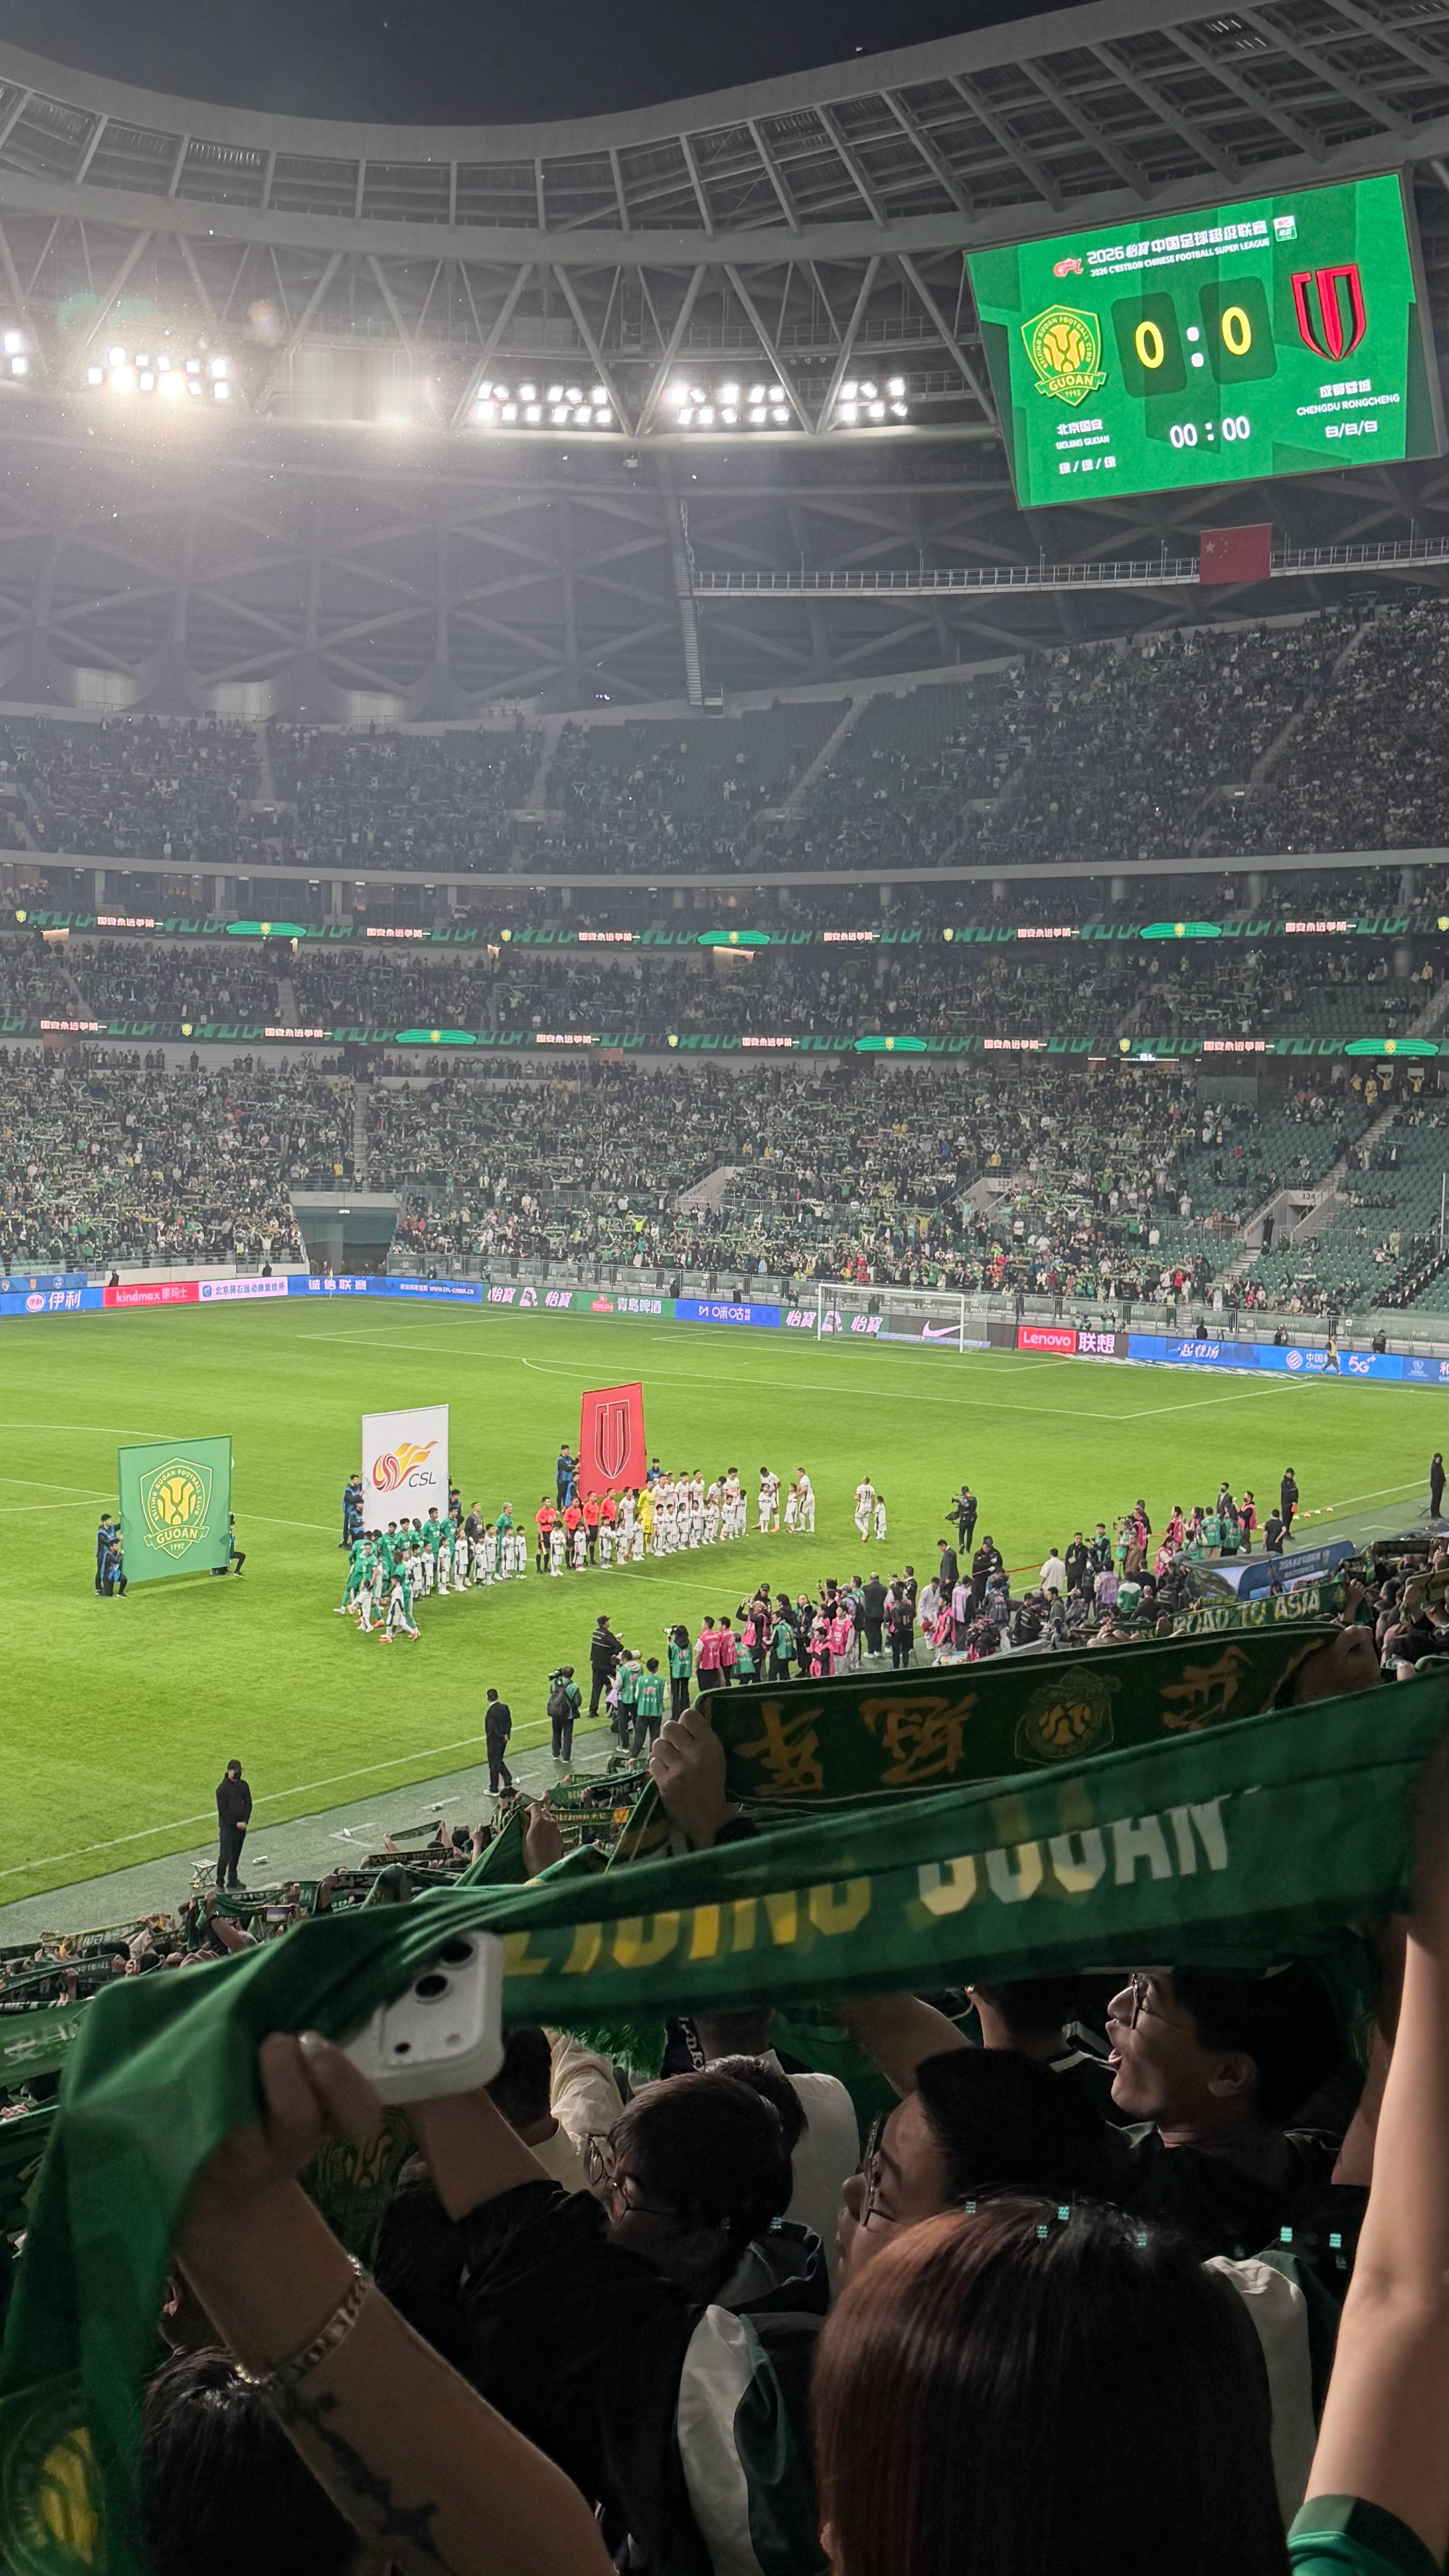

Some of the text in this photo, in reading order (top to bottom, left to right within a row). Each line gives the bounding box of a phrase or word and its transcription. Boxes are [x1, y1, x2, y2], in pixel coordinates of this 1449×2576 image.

[1144, 255, 1174, 267] CHINESE
[1175, 248, 1214, 262] FOOTBALL
[1214, 244, 1239, 255] SUPER
[1240, 238, 1270, 251] LEAGUE
[1049, 376, 1094, 391] GUOAN
[1064, 388, 1081, 398] 1992
[1296, 393, 1400, 416] CHENGDU RONGCHENG
[1057, 419, 1103, 436] 北京国安
[1084, 435, 1110, 446] GUOAN
[48, 1290, 81, 1310] 伊利
[116, 1291, 160, 1302] kindmax
[1023, 1330, 1114, 1354] Lenovo 联想
[409, 1472, 437, 1488] CSL
[156, 1528, 198, 1545] GUOAN
[1237, 1600, 1266, 1627] TO
[1274, 1587, 1320, 1620] ASIA
